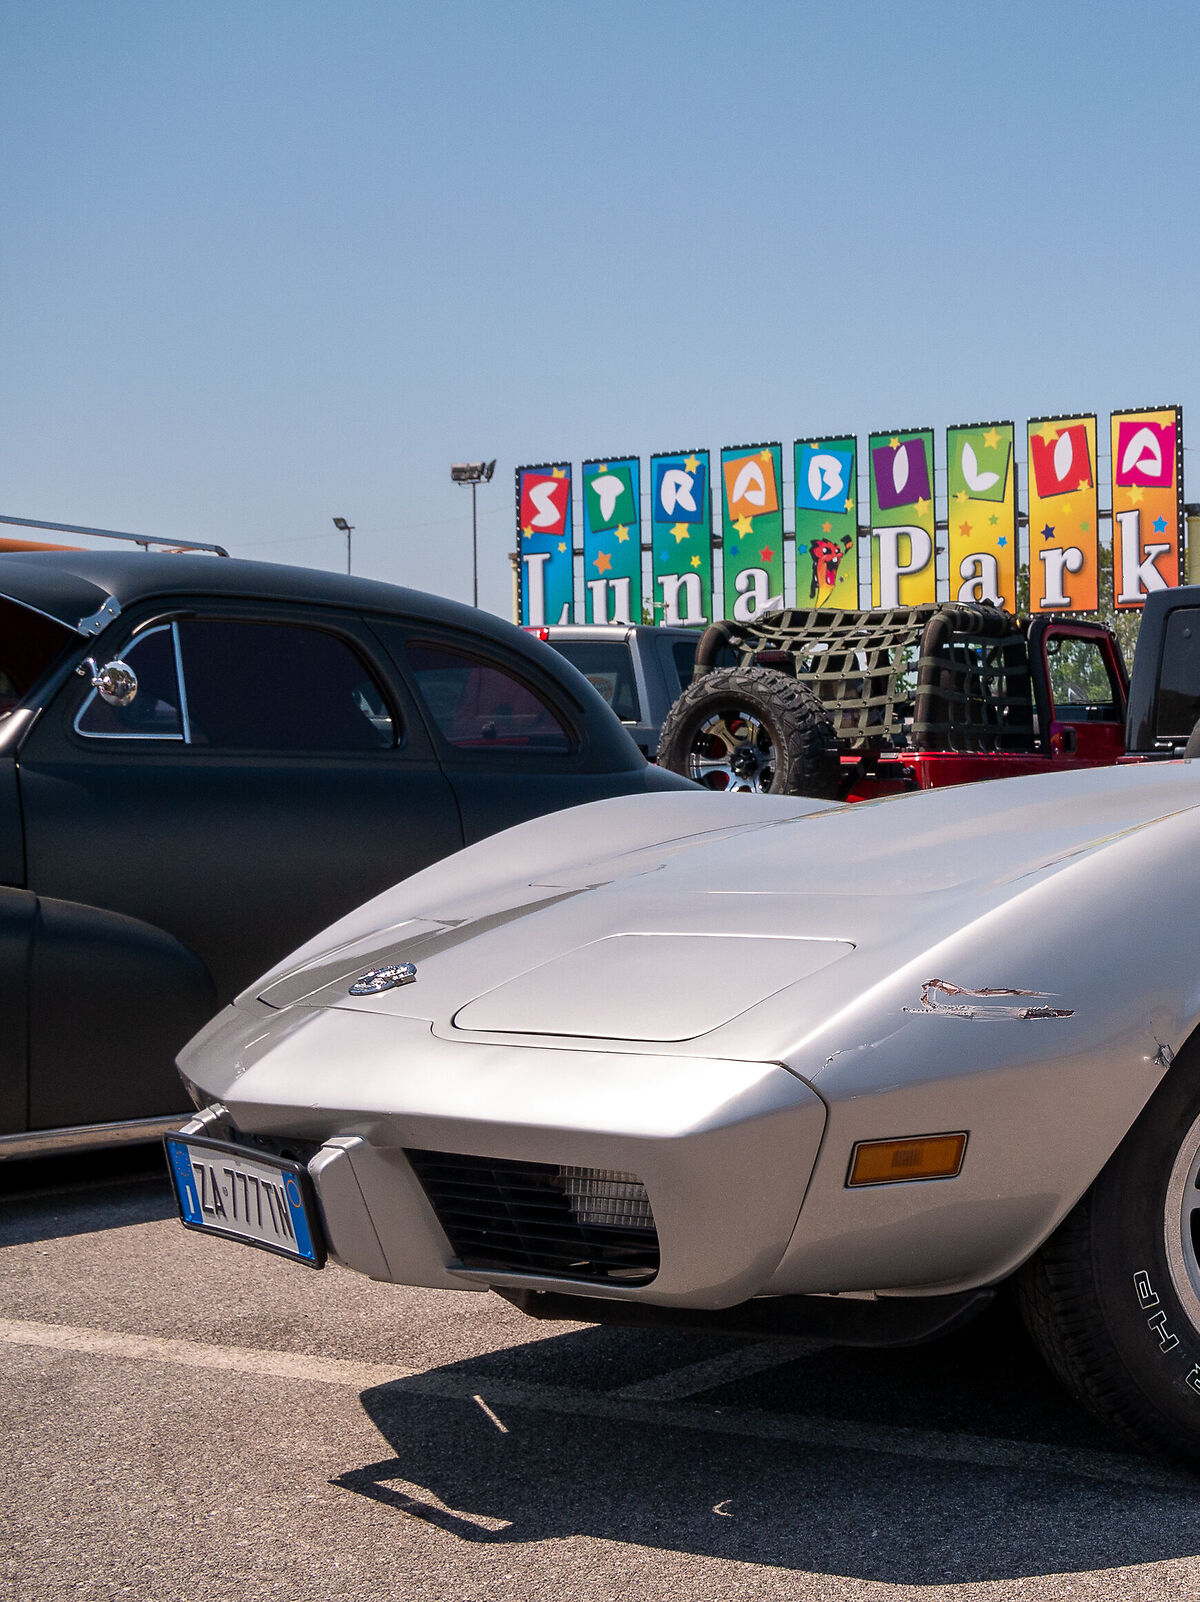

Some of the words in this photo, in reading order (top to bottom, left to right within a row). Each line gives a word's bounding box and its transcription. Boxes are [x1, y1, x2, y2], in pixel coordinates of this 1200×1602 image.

[527, 425, 1164, 528] STRABILIA
[523, 553, 772, 627] Luna
[872, 510, 1170, 610] Park
[1133, 1270, 1179, 1354] HP
